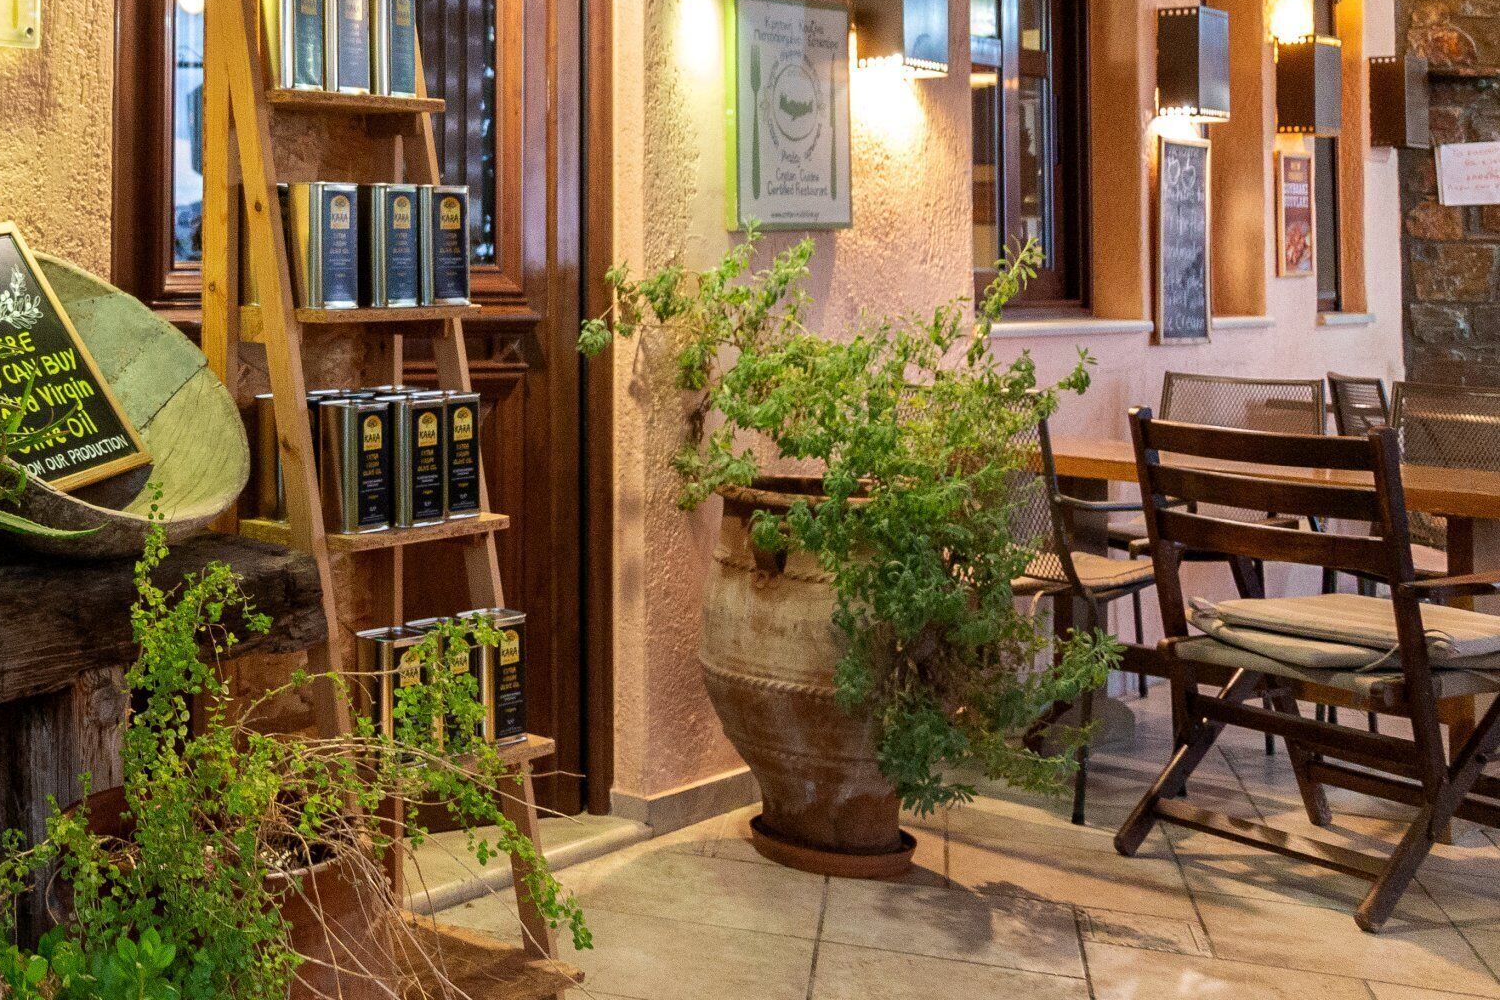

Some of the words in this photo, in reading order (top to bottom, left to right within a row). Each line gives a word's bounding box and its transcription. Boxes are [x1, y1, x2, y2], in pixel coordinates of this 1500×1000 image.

[2, 358, 43, 384] CAN
[40, 348, 77, 375] BUY
[35, 377, 95, 411] Virgin
[66, 409, 98, 438] Oil
[45, 453, 70, 471] OUR
[67, 434, 129, 465] PRODUCTION
